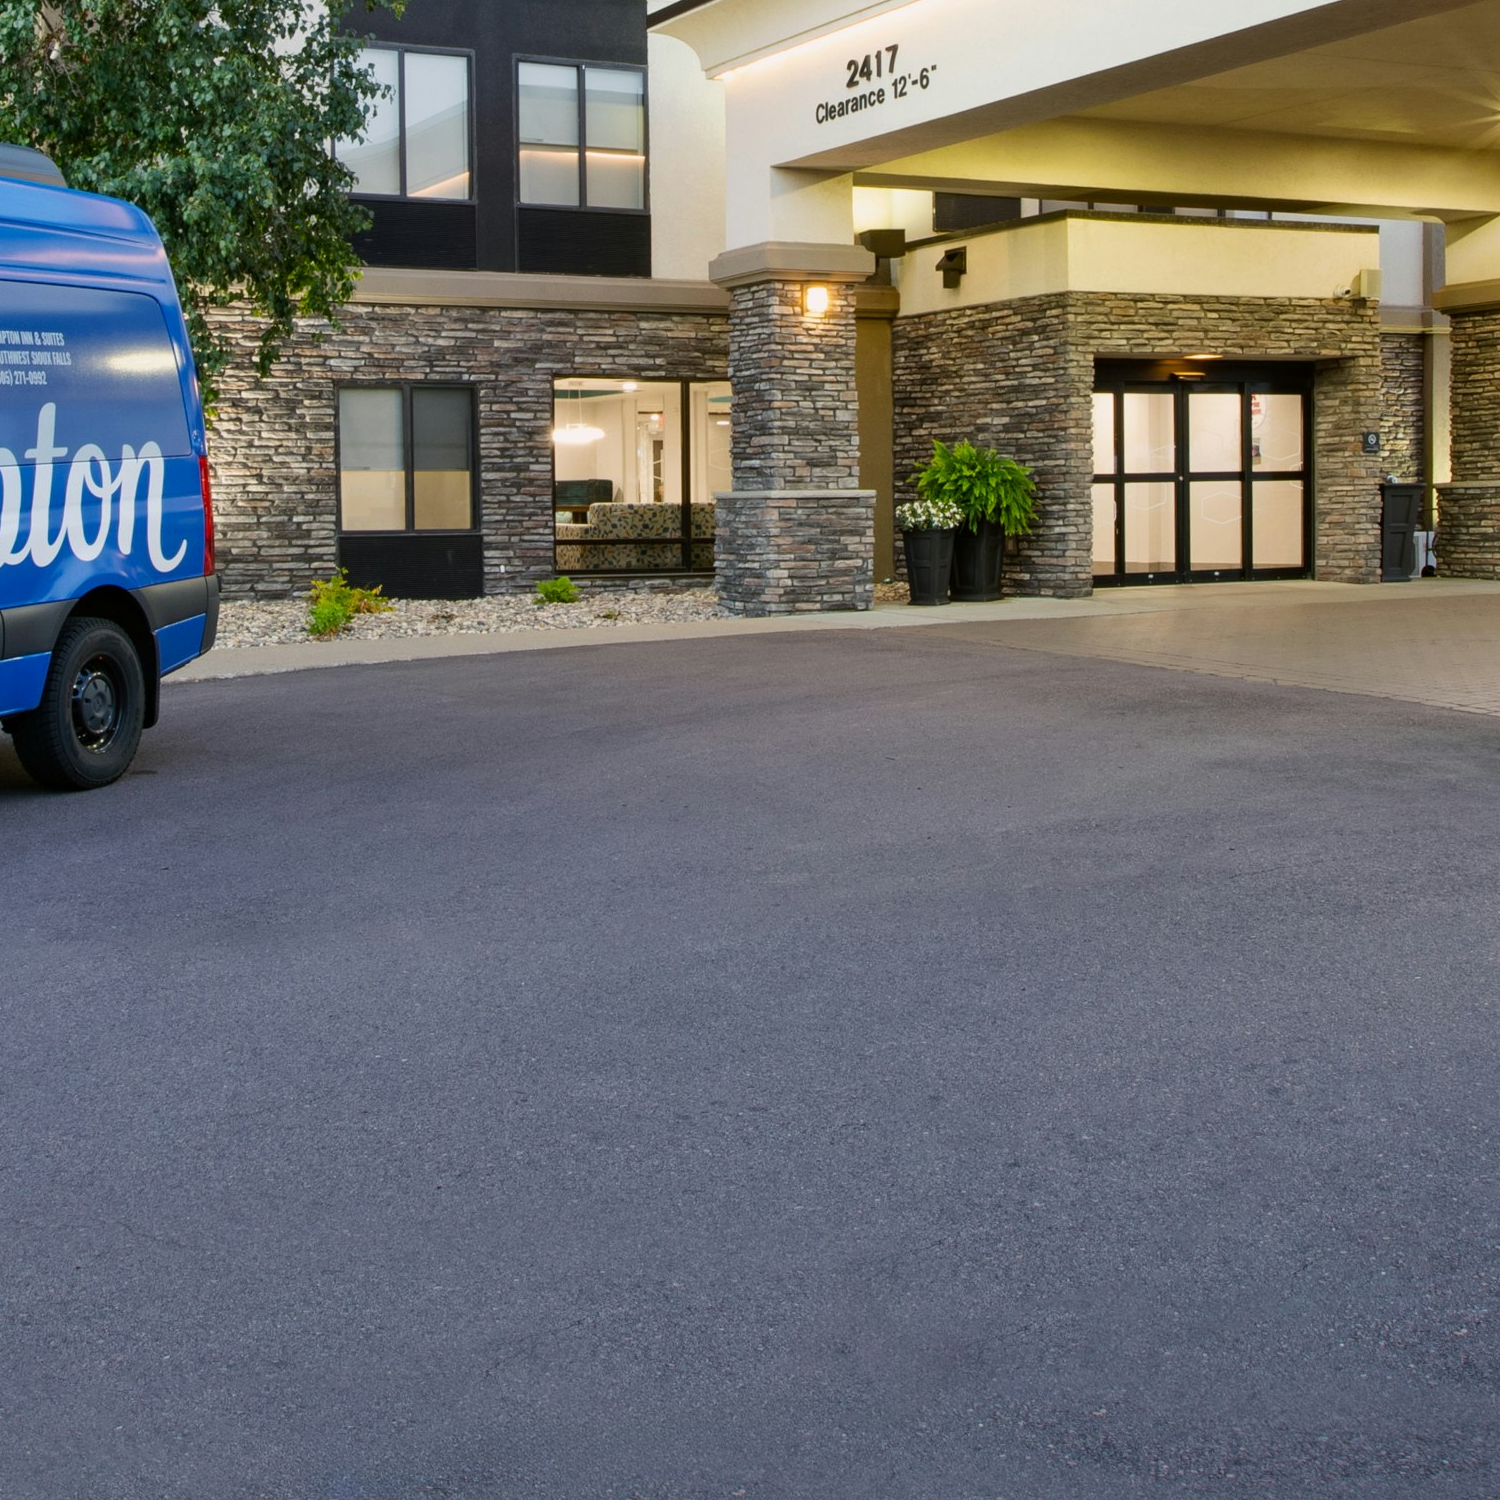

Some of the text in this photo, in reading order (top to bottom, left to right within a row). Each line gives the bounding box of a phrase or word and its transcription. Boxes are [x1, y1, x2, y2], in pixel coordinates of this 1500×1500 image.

[846, 44, 898, 88] 2417
[816, 88, 885, 124] Clearance
[20, 331, 34, 345] INN
[34, 331, 42, 346] &
[41, 332, 65, 346] SUITES
[31, 351, 53, 365] SIOUX
[52, 352, 72, 366] FALLS
[13, 370, 47, 385] 271-0992
